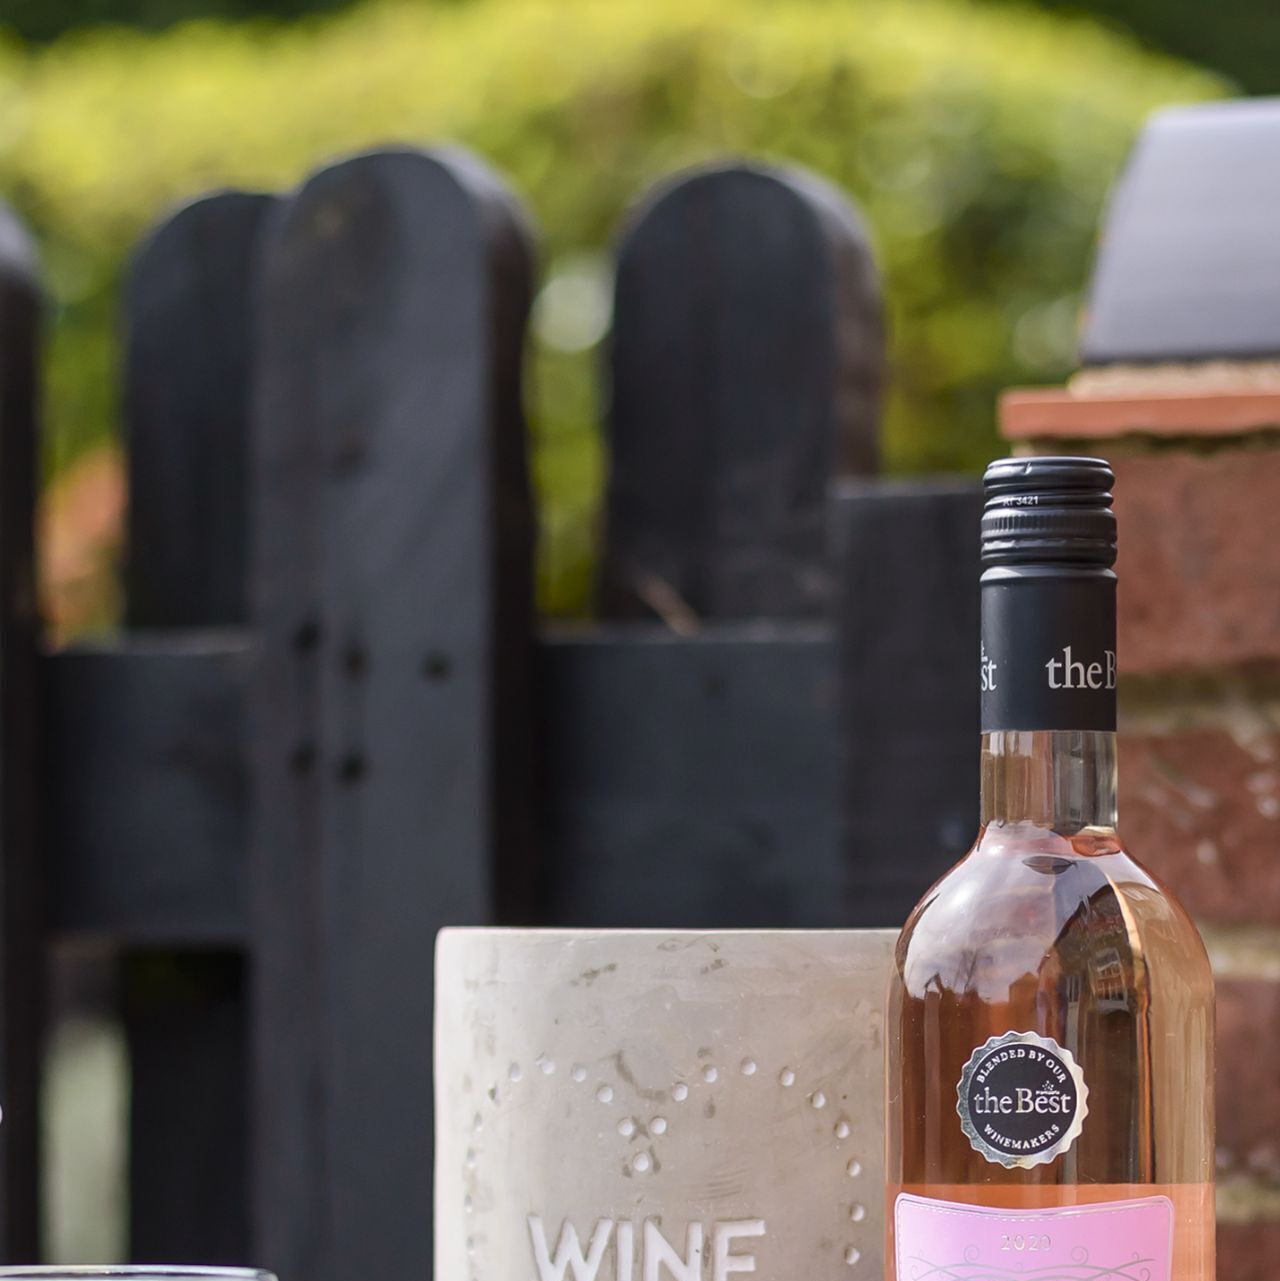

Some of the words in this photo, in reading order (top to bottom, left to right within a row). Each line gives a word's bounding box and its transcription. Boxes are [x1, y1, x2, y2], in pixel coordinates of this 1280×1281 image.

[976, 1049, 1025, 1083] BLENDED
[1028, 1050, 1046, 1062] BY
[1045, 1058, 1067, 1083] OUR
[973, 1087, 1012, 1114] the
[1015, 1088, 1071, 1114] Best
[984, 1123, 1060, 1150] WINEMAKERS
[1001, 1235, 1052, 1251] 2020
